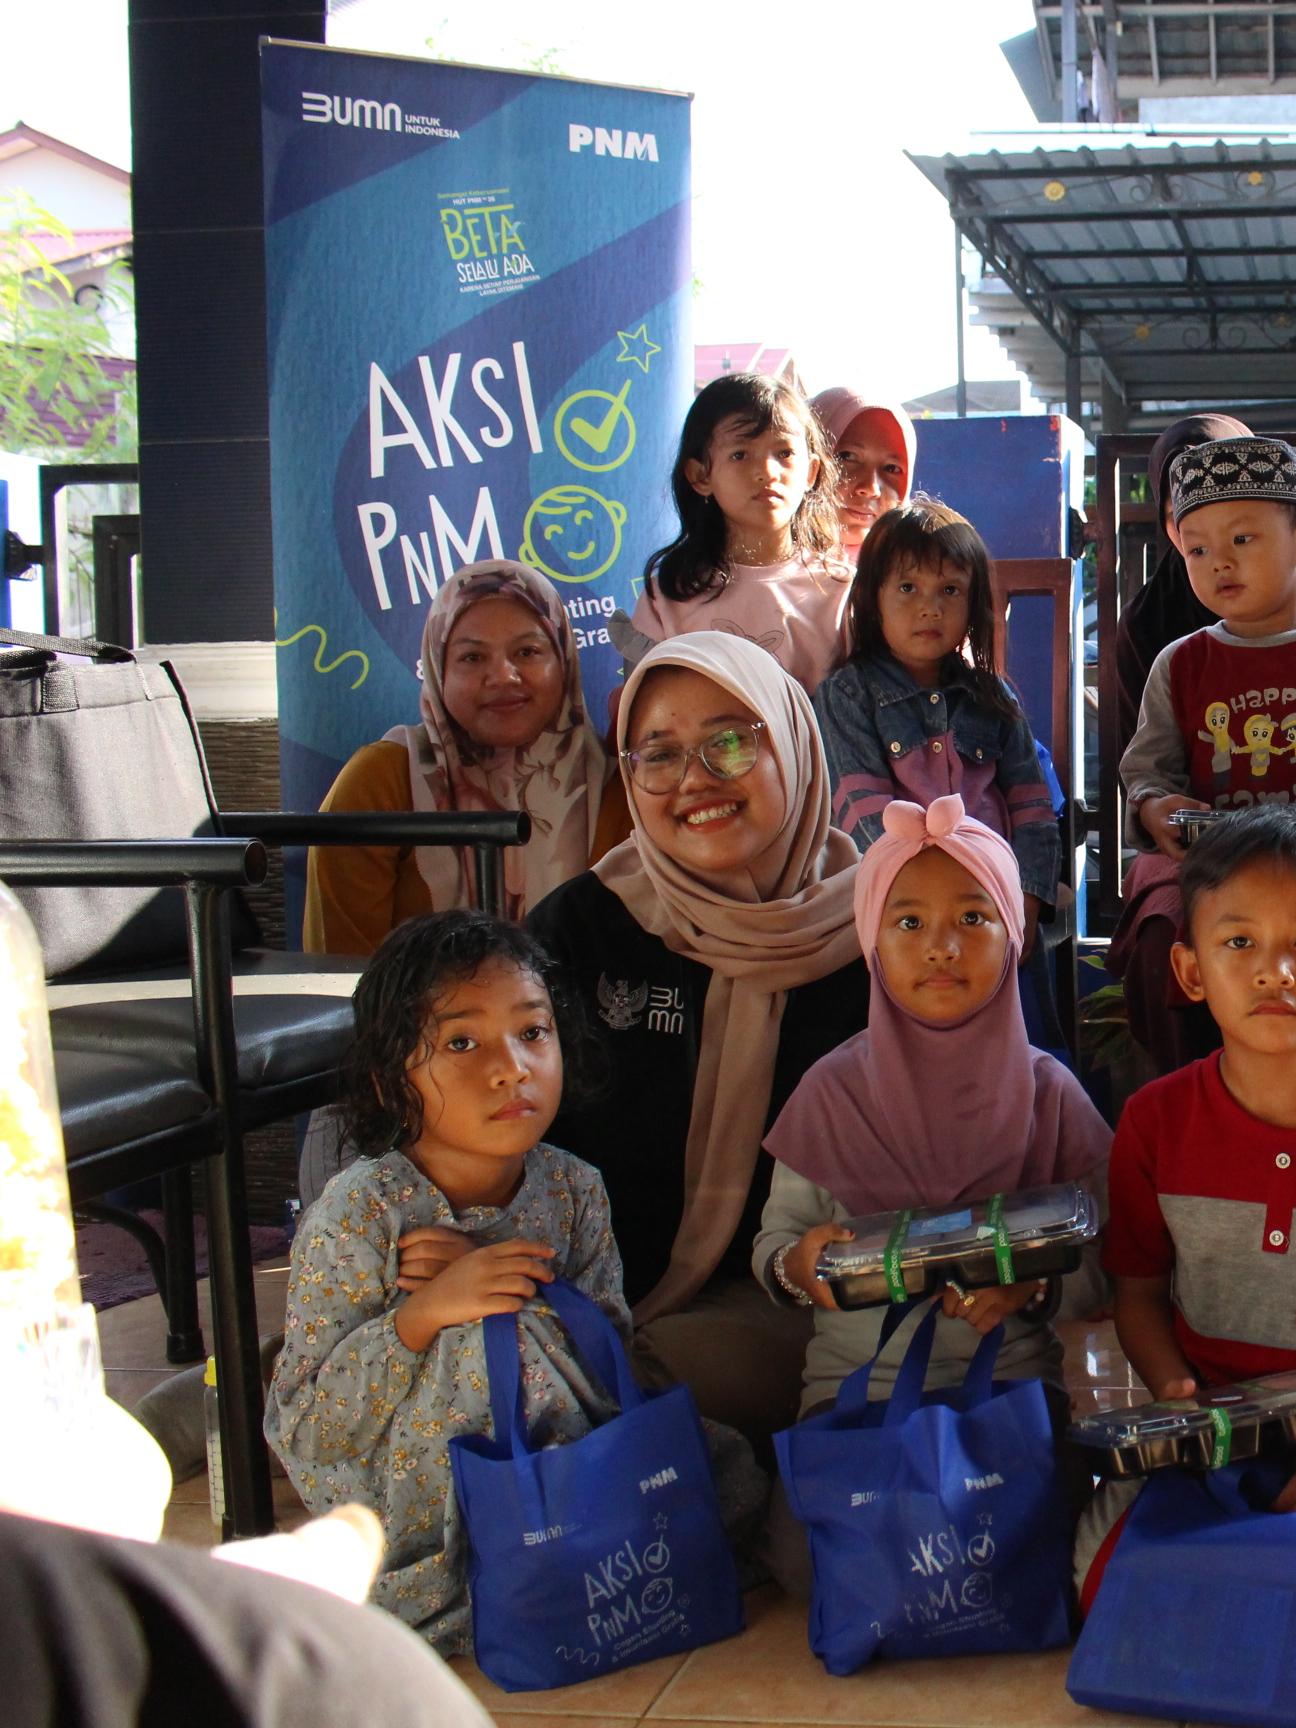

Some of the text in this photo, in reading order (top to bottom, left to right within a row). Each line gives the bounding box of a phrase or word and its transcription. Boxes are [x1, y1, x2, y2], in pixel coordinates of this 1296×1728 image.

[302, 92, 441, 132] BUMN UNTUK
[405, 124, 460, 139] INDONESIA
[568, 124, 659, 162] PNM
[440, 204, 526, 260] BETA
[456, 254, 535, 283] SELALU ADA
[369, 340, 544, 479] AKSI
[356, 486, 505, 610] PNM
[575, 627, 611, 650] Gra
[639, 1466, 679, 1495] PNM
[582, 1540, 642, 1609] AKSI
[586, 1594, 641, 1647] PNM
